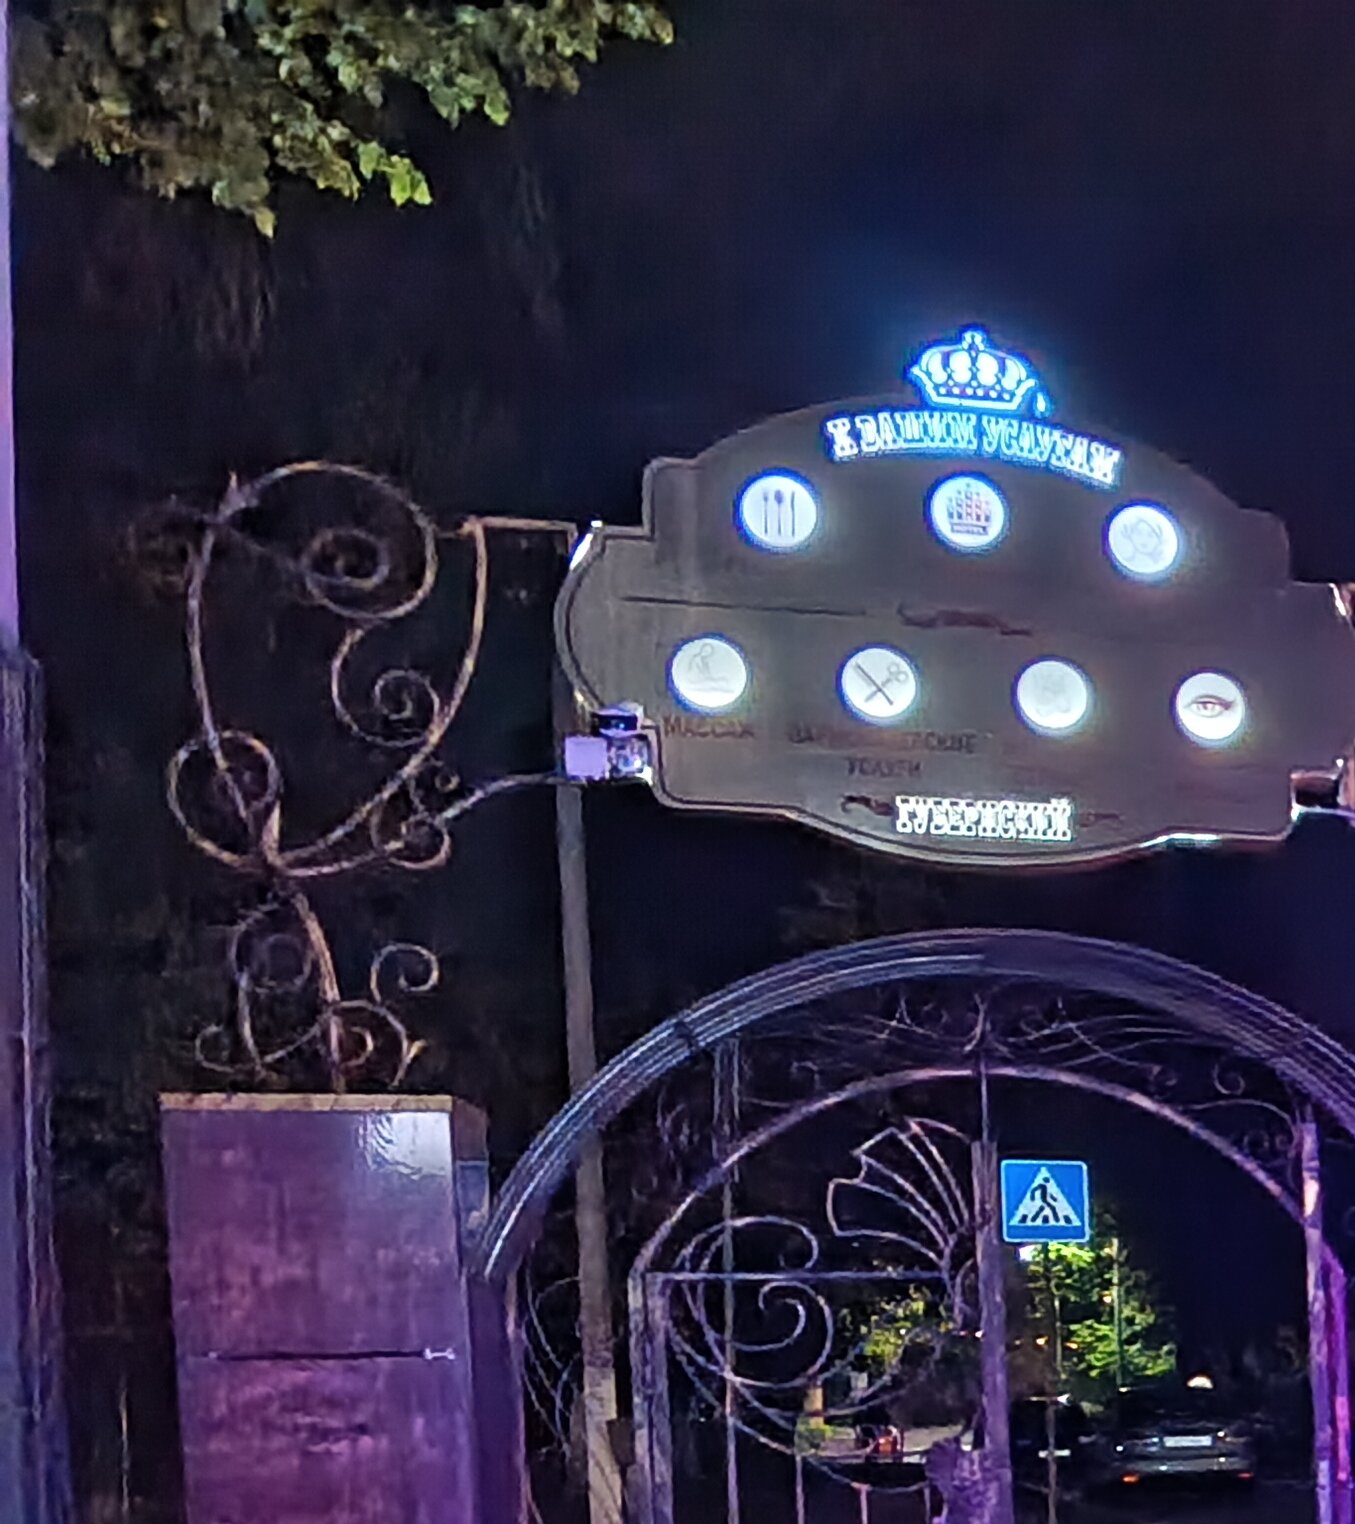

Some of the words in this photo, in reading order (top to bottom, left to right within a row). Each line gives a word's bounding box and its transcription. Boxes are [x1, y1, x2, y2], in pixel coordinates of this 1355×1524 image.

[855, 411, 977, 452] ВАШИМ
[981, 414, 1121, 485] УСЛУГАМ
[896, 796, 1072, 841] ГУБЕРНСКИЙ
